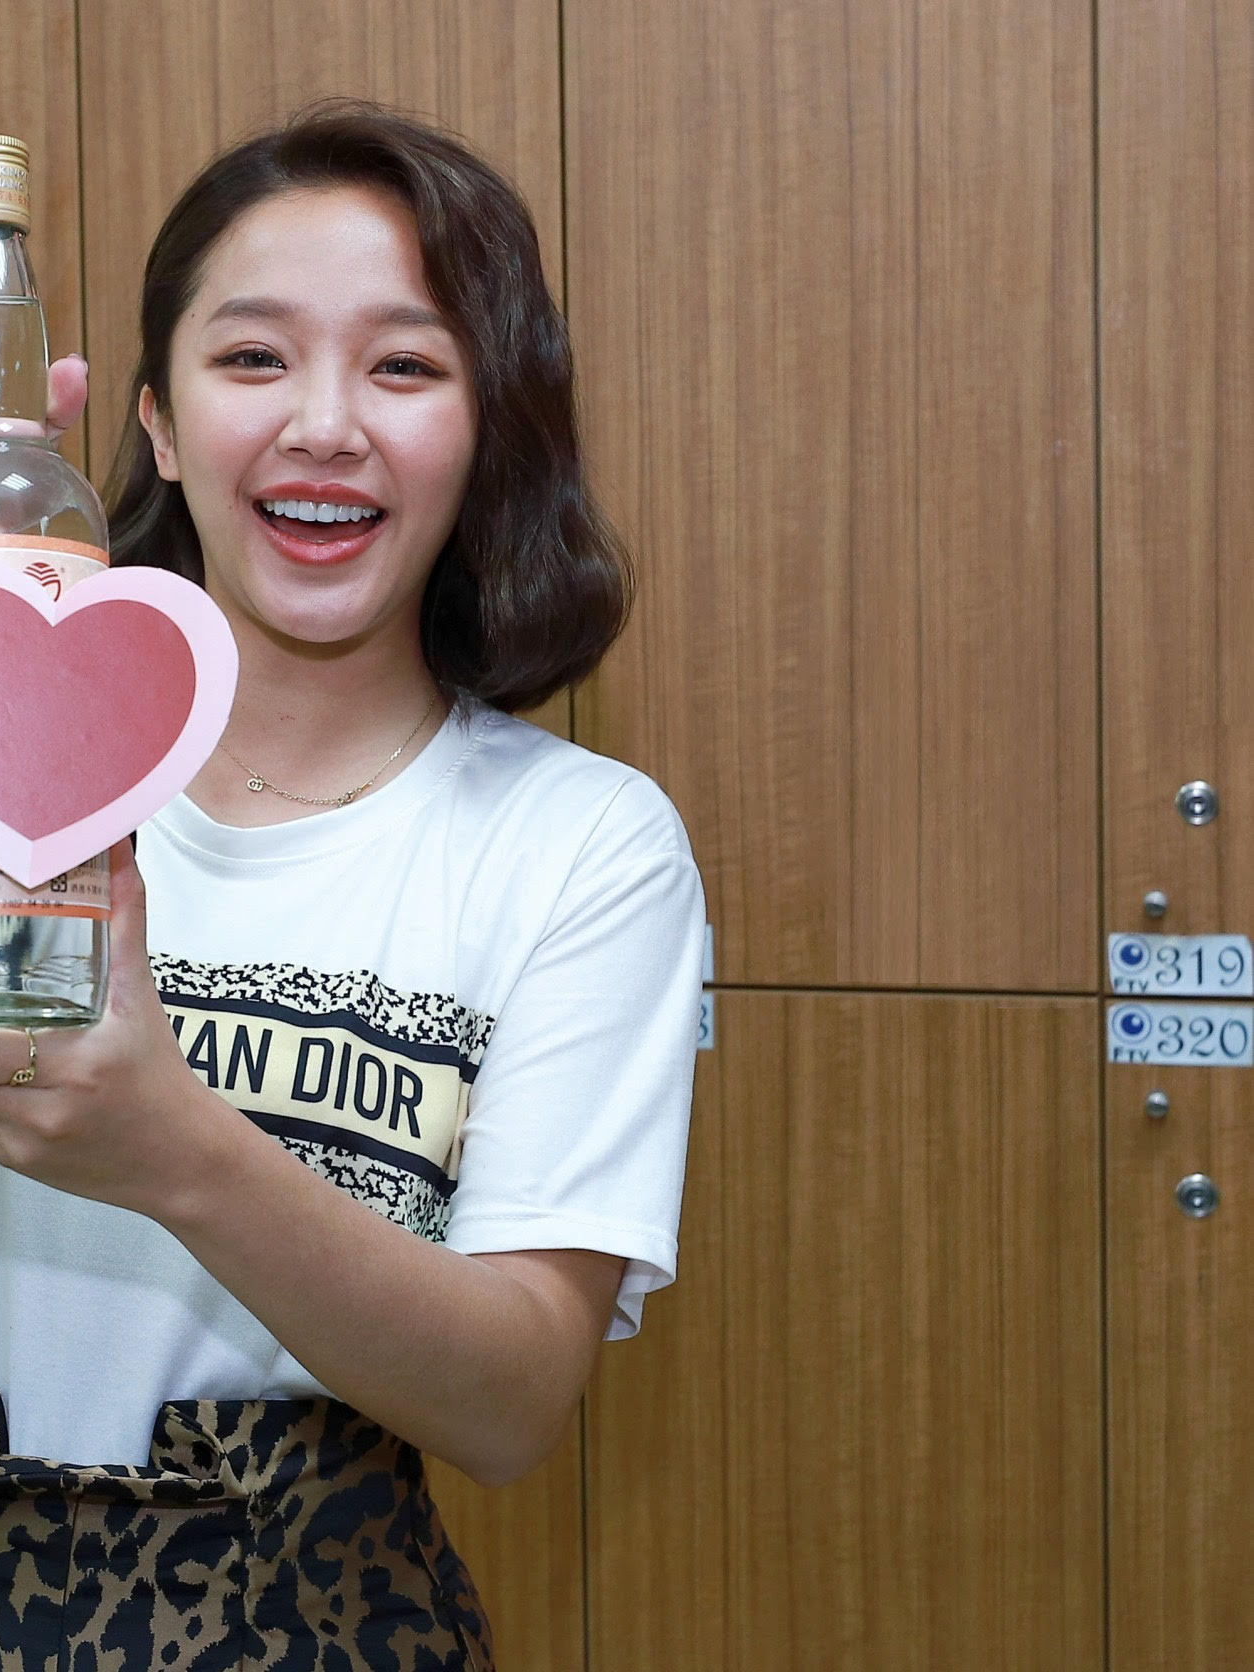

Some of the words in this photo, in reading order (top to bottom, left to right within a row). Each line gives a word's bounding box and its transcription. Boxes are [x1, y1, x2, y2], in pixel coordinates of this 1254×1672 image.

[1155, 945, 1245, 987] 319
[1157, 1015, 1249, 1059] 320
[290, 1036, 424, 1139] DIOR
